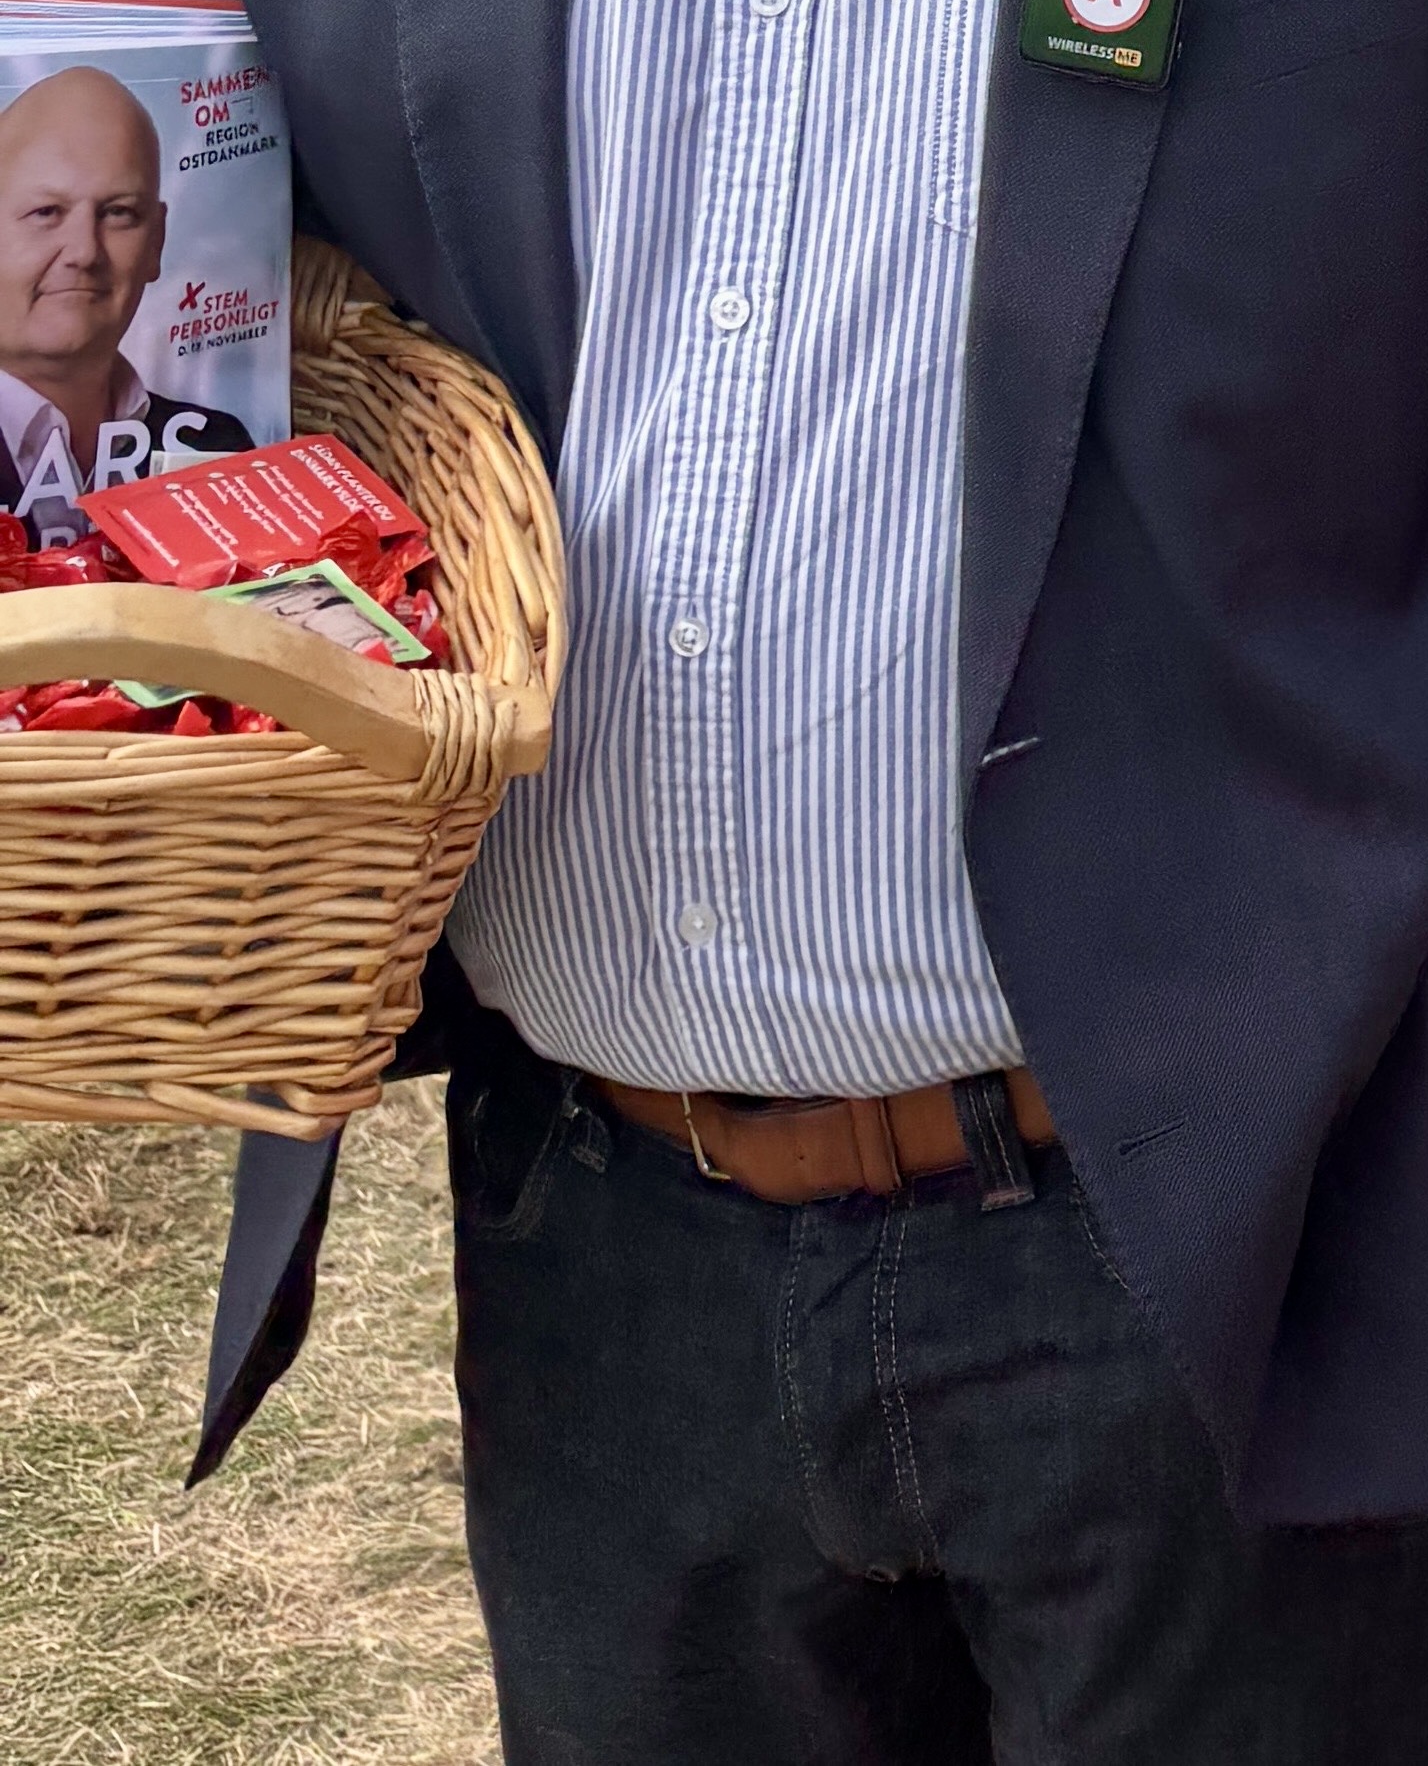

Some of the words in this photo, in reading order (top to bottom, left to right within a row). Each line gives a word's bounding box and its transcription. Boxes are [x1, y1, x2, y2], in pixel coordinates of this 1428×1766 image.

[195, 100, 230, 127] OM
[206, 122, 259, 146] REGION
[203, 288, 248, 314] STEM
[169, 300, 279, 343] PERSONLIGT
